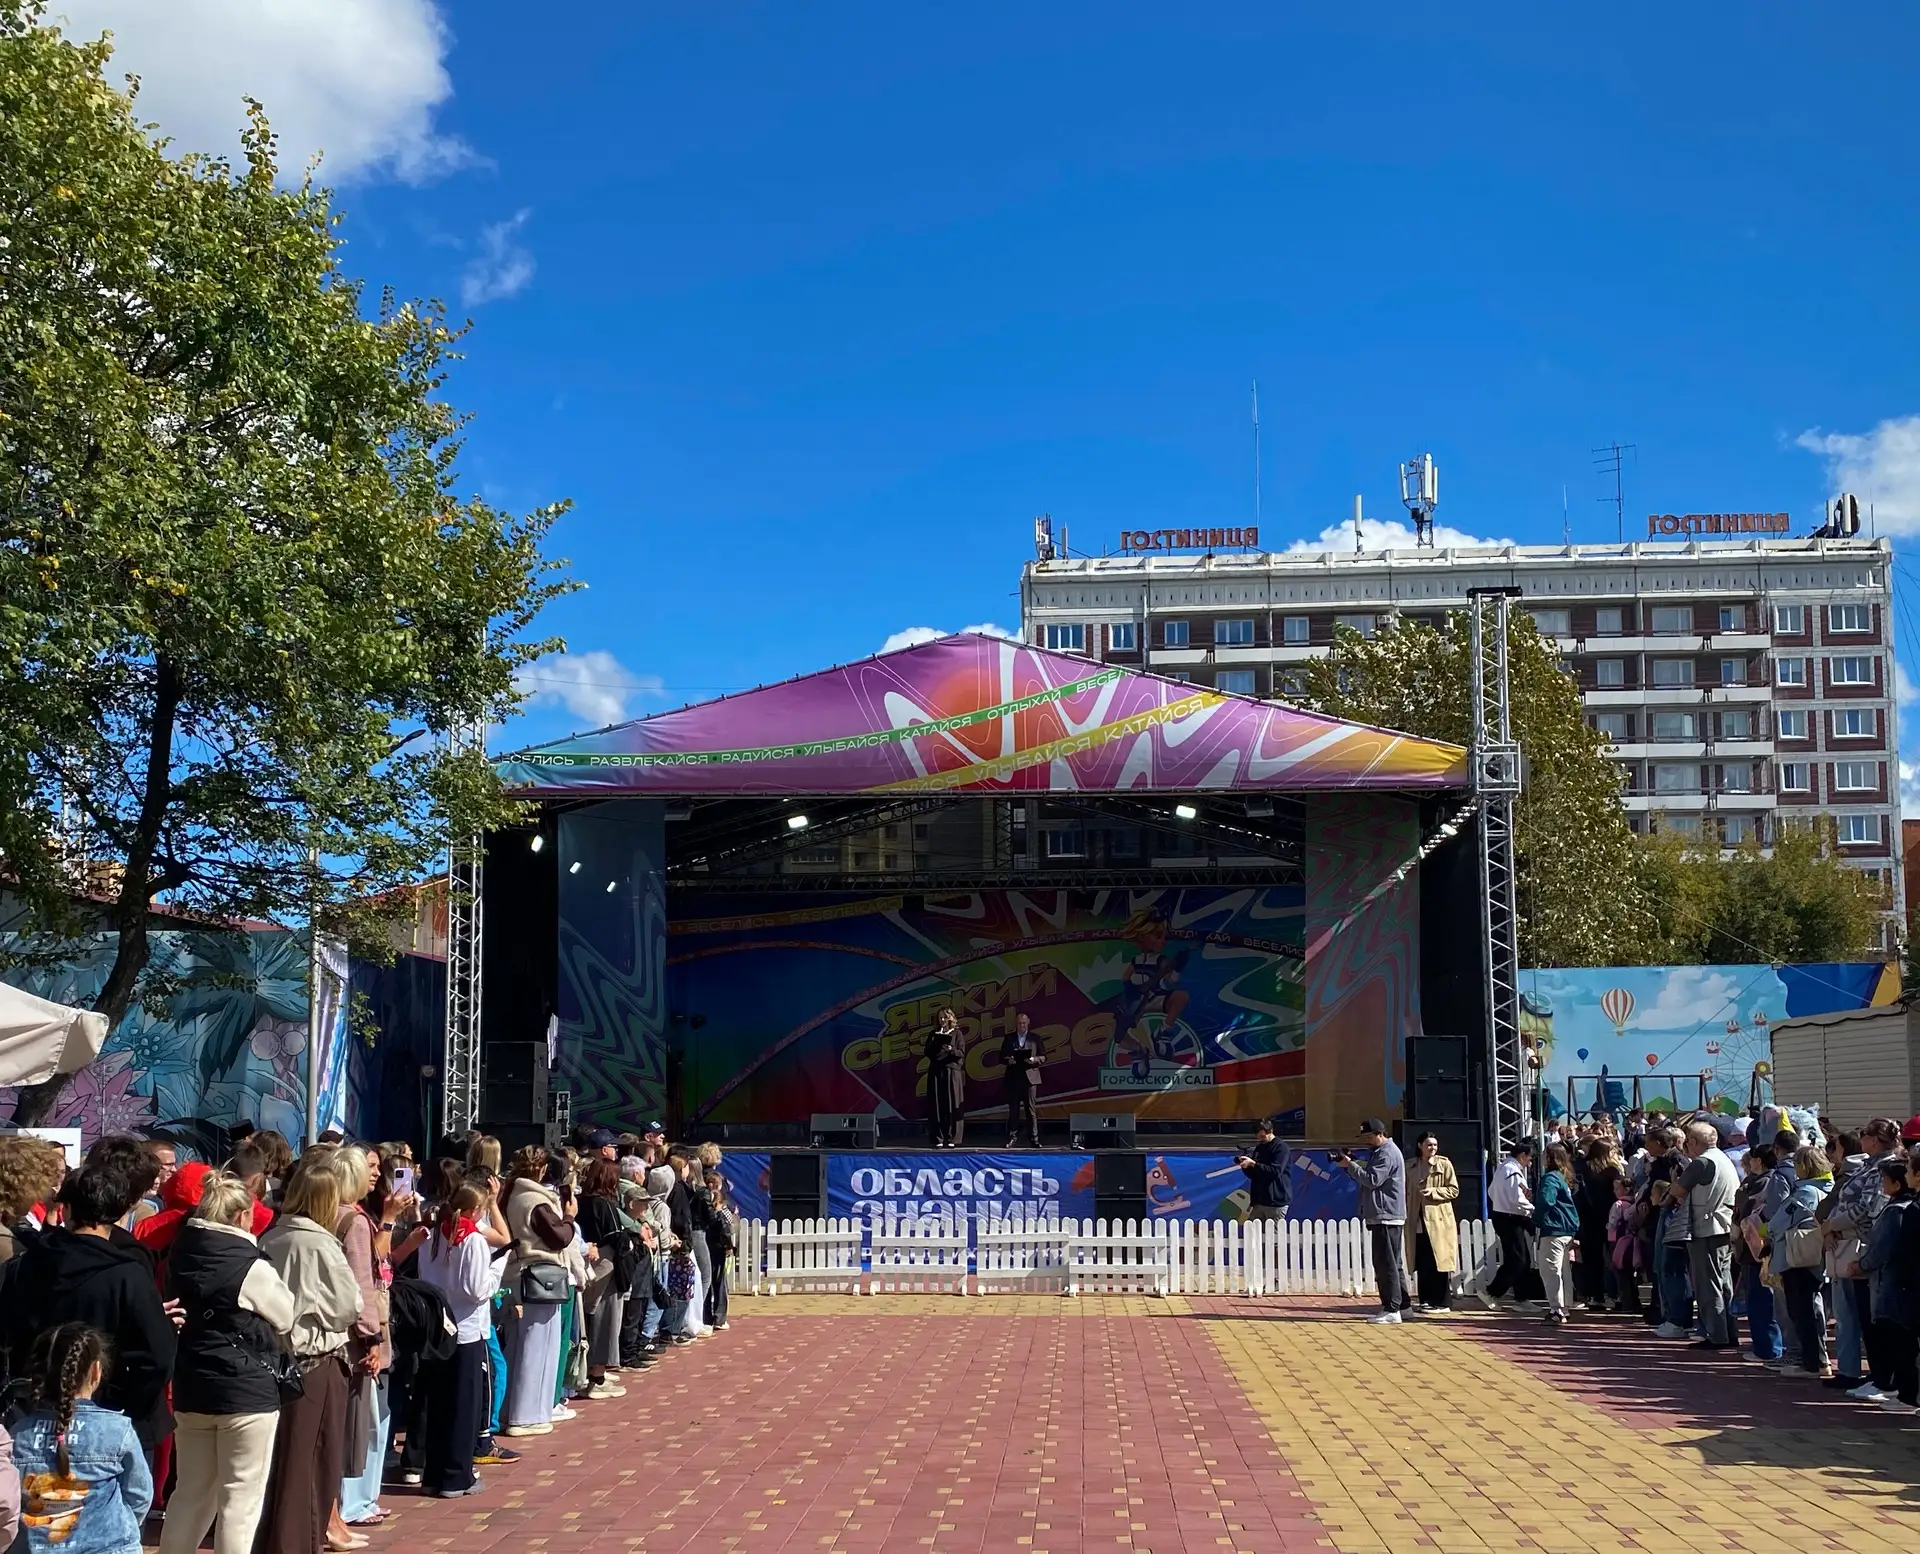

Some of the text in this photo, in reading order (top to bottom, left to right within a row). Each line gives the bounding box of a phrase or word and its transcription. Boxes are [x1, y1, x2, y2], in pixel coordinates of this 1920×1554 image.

[1648, 512, 1790, 535] ГОСТИНИЦА
[1119, 526, 1259, 550] ГОСТИНИЦА
[590, 753, 708, 767] РАЗВЛЕКАЙСЯ
[720, 747, 794, 763] РАДУЙСЯ
[803, 732, 890, 757] УЛЫБАЙСЯ
[899, 715, 972, 740] КАТАЙСЯ
[986, 688, 1064, 721] ОТДЫХАЙ
[973, 736, 1091, 779] УЛЫБАЙСЯ
[1104, 698, 1204, 743] КАТАЙСЯ
[789, 898, 901, 924] РАЗВЛЕКАЙС
[884, 962, 1058, 1035] ЯРКИЙ
[1184, 1074, 1212, 1085] САД
[33, 1433, 79, 1450] BER
